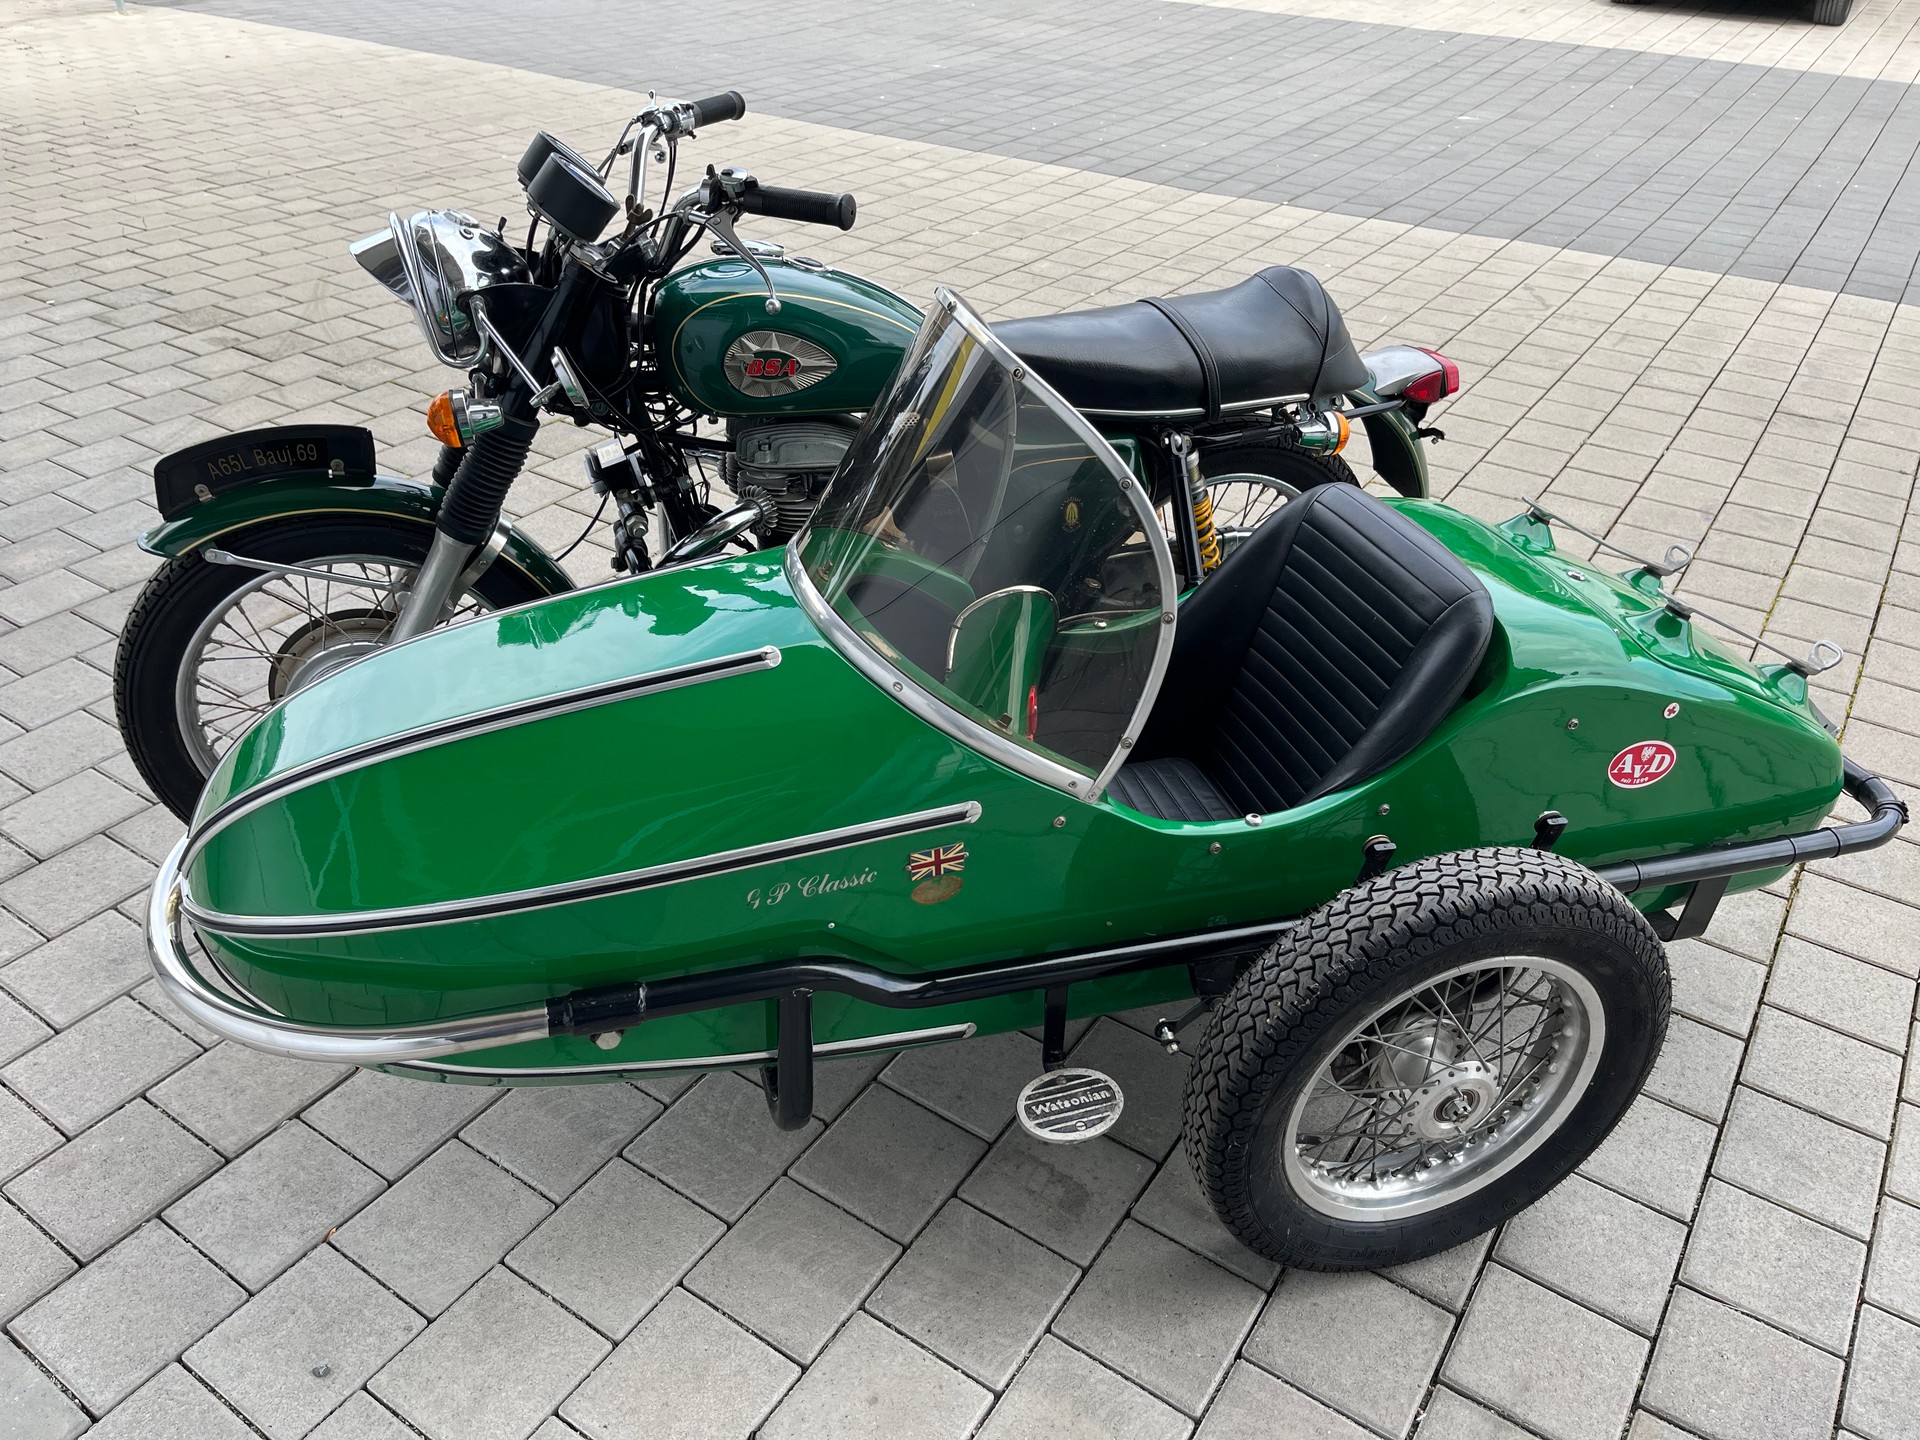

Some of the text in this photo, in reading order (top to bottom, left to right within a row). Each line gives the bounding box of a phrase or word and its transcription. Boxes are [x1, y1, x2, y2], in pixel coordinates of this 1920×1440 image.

[746, 358, 798, 377] BSA
[207, 453, 252, 480] A65L
[766, 882, 791, 906] P
[797, 867, 878, 898] Classic
[1031, 1089, 1111, 1116] Watsonian
